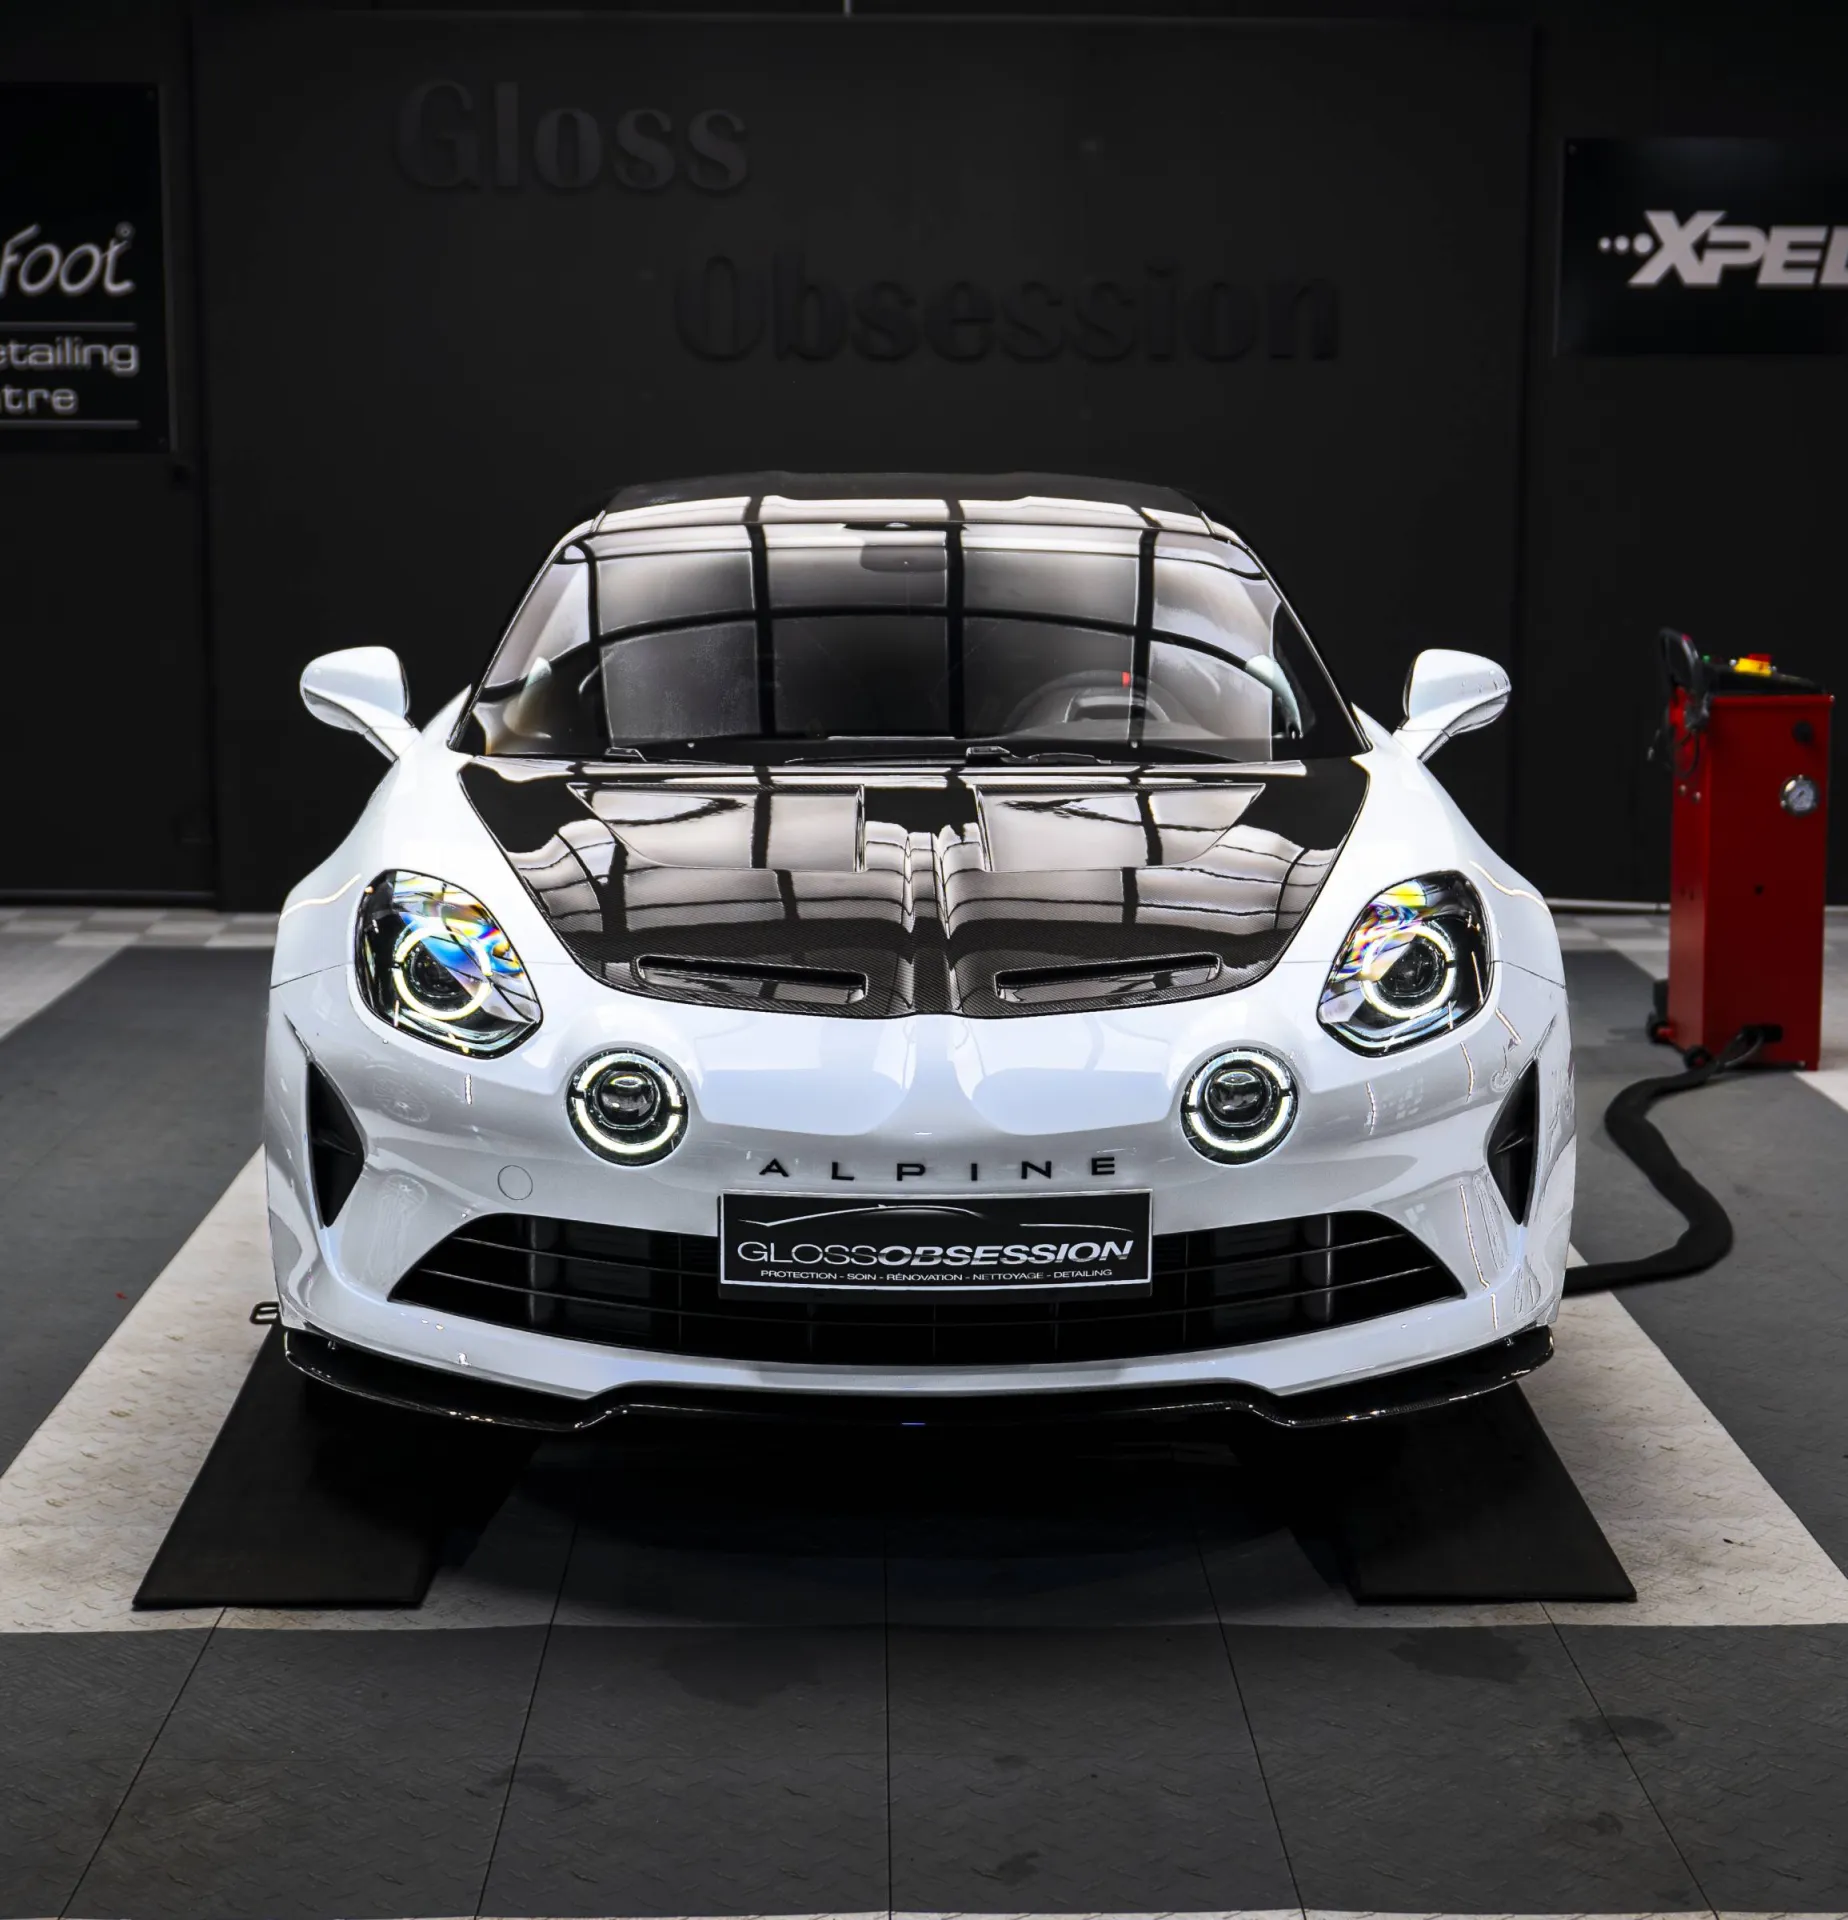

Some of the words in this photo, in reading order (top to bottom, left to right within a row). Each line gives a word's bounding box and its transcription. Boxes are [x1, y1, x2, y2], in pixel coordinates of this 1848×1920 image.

[397, 78, 750, 194] Gloss
[1626, 208, 1848, 288] XPEL
[672, 250, 1344, 364] Obsession
[0, 383, 79, 415] tre
[759, 1156, 1117, 1182] ALPINE
[737, 1240, 1134, 1266] GLOSSOBSESSION
[760, 1269, 838, 1280] PROTECTION
[846, 1272, 877, 1281] SOIN
[972, 1272, 1045, 1281] NETTOYAGE
[1053, 1268, 1113, 1279] DETAILING
